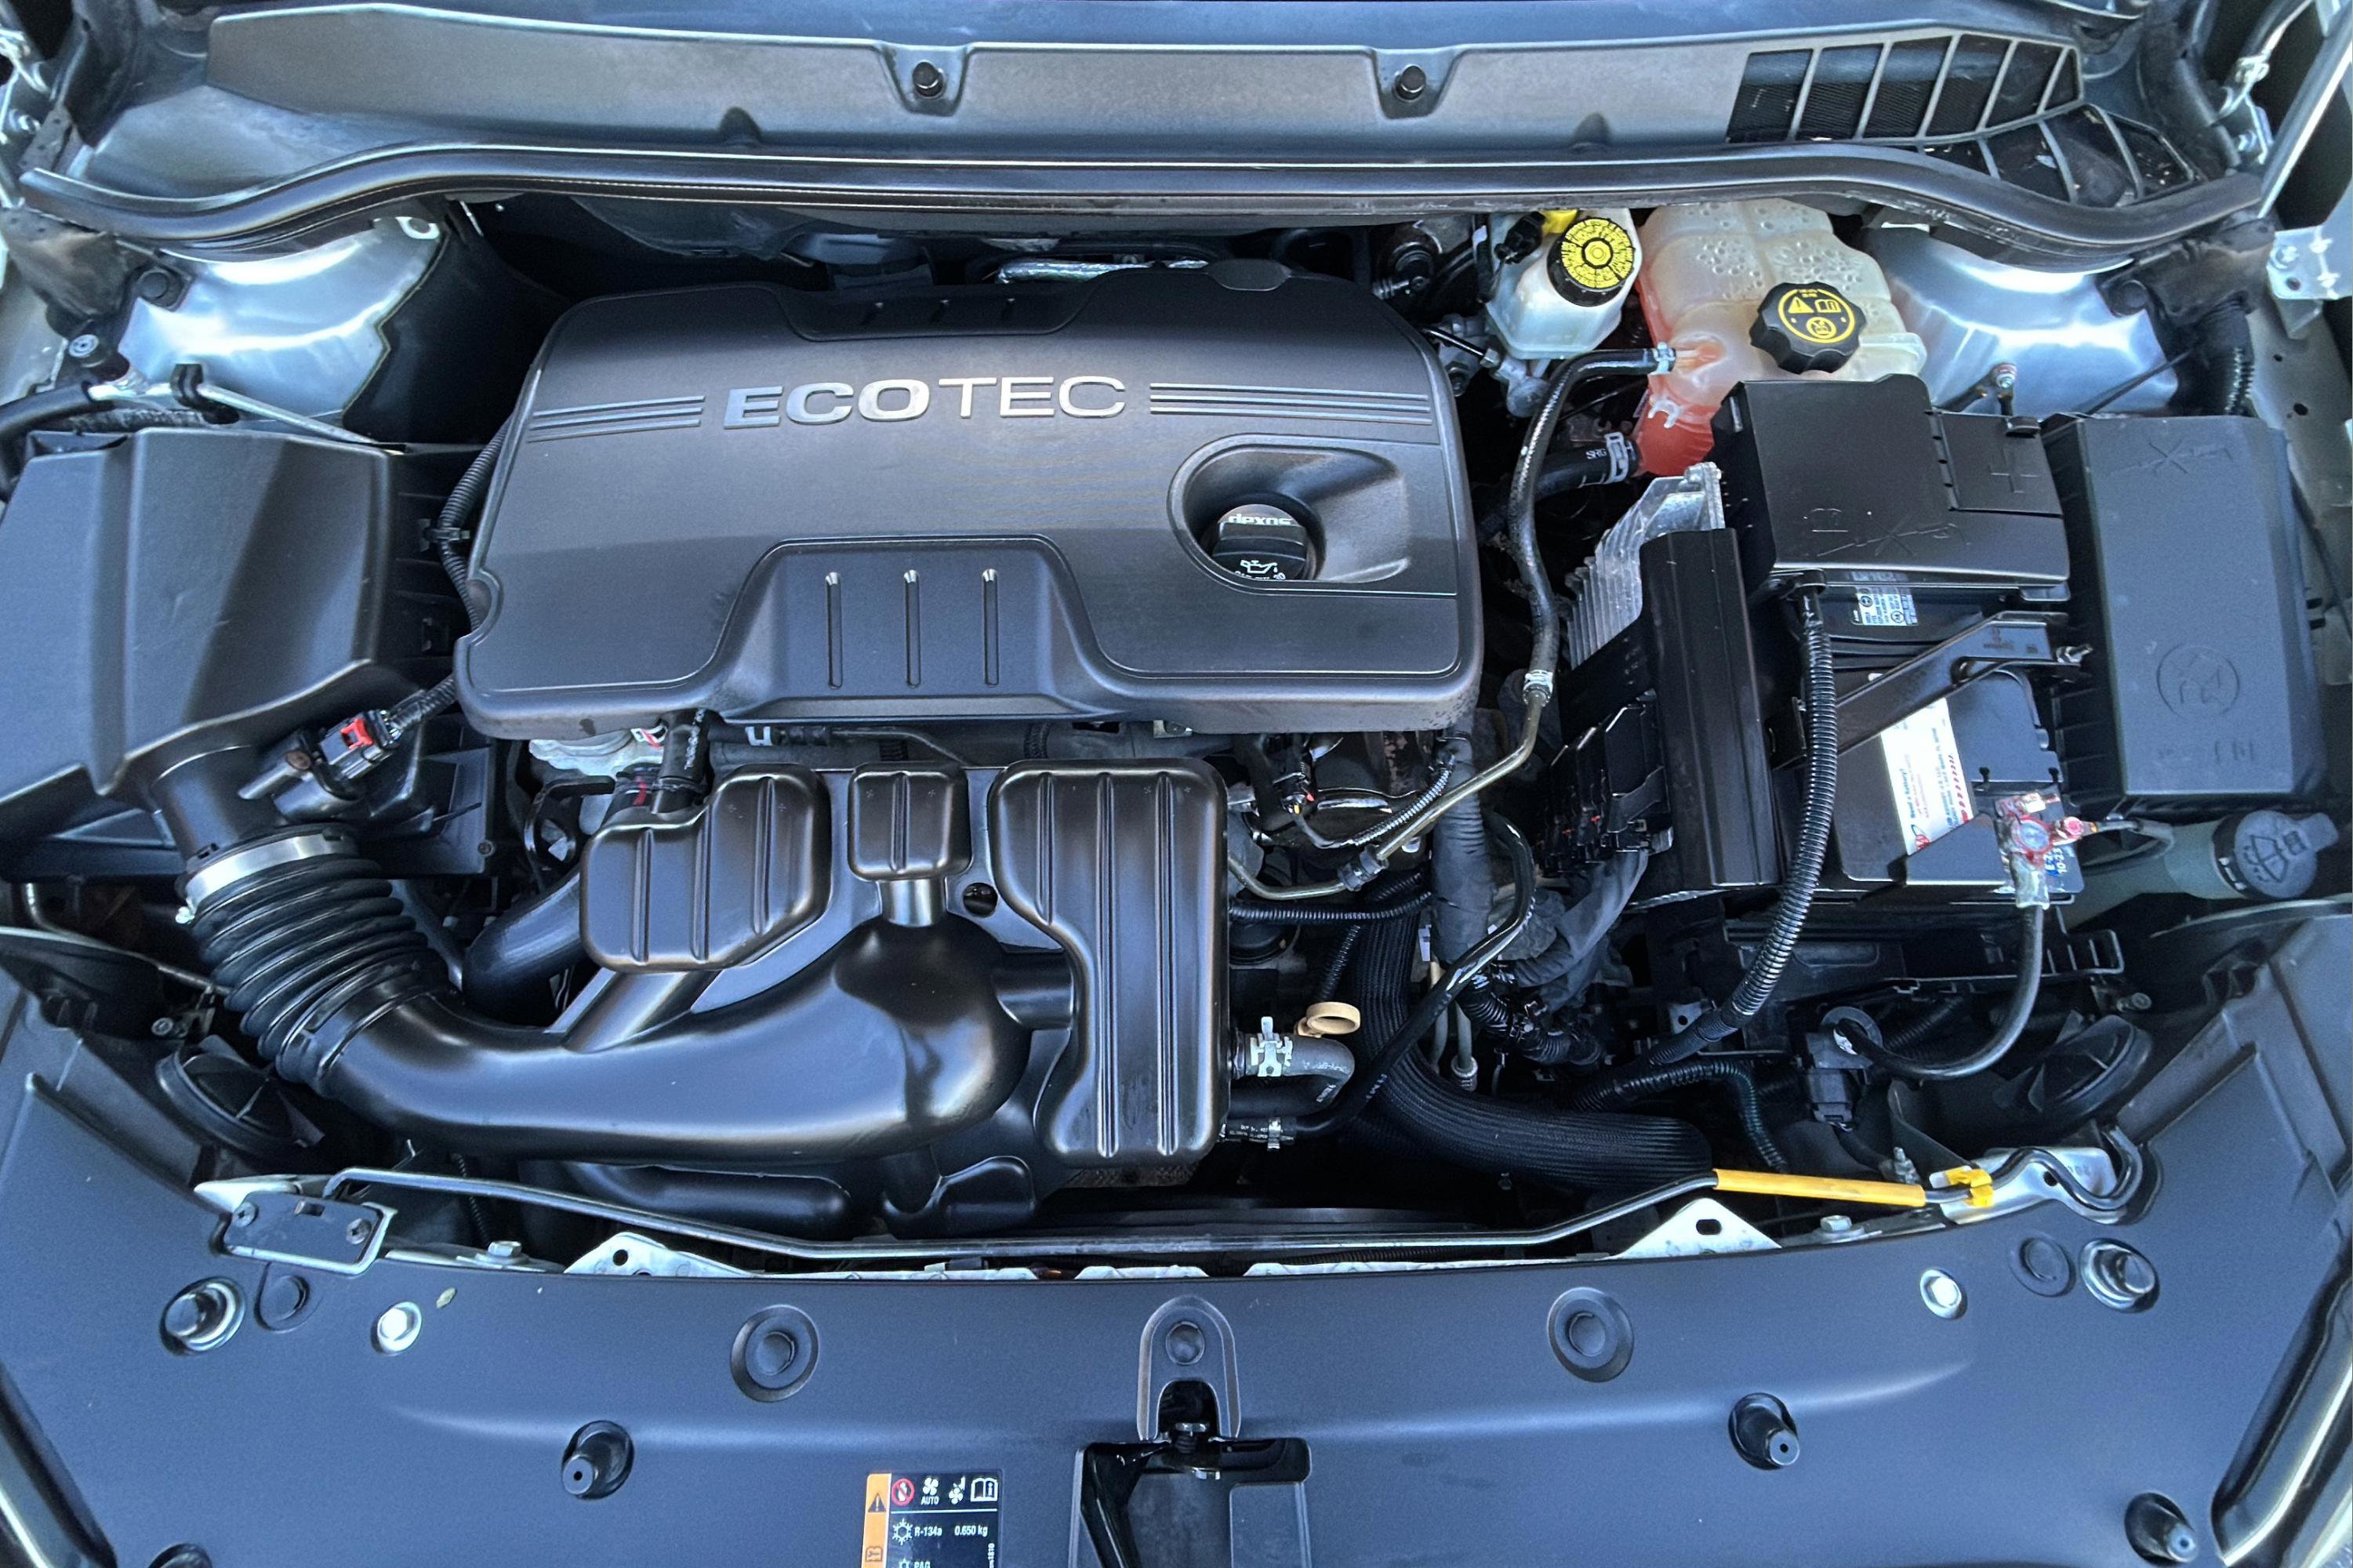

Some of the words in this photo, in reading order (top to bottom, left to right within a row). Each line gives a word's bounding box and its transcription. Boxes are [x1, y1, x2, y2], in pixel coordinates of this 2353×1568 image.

[723, 376, 1126, 430] ECOTEC
[921, 1496, 939, 1505] AUTO
[914, 1526, 942, 1537] R-134a
[954, 1525, 976, 1537] 0.650
[977, 1525, 988, 1537] kg
